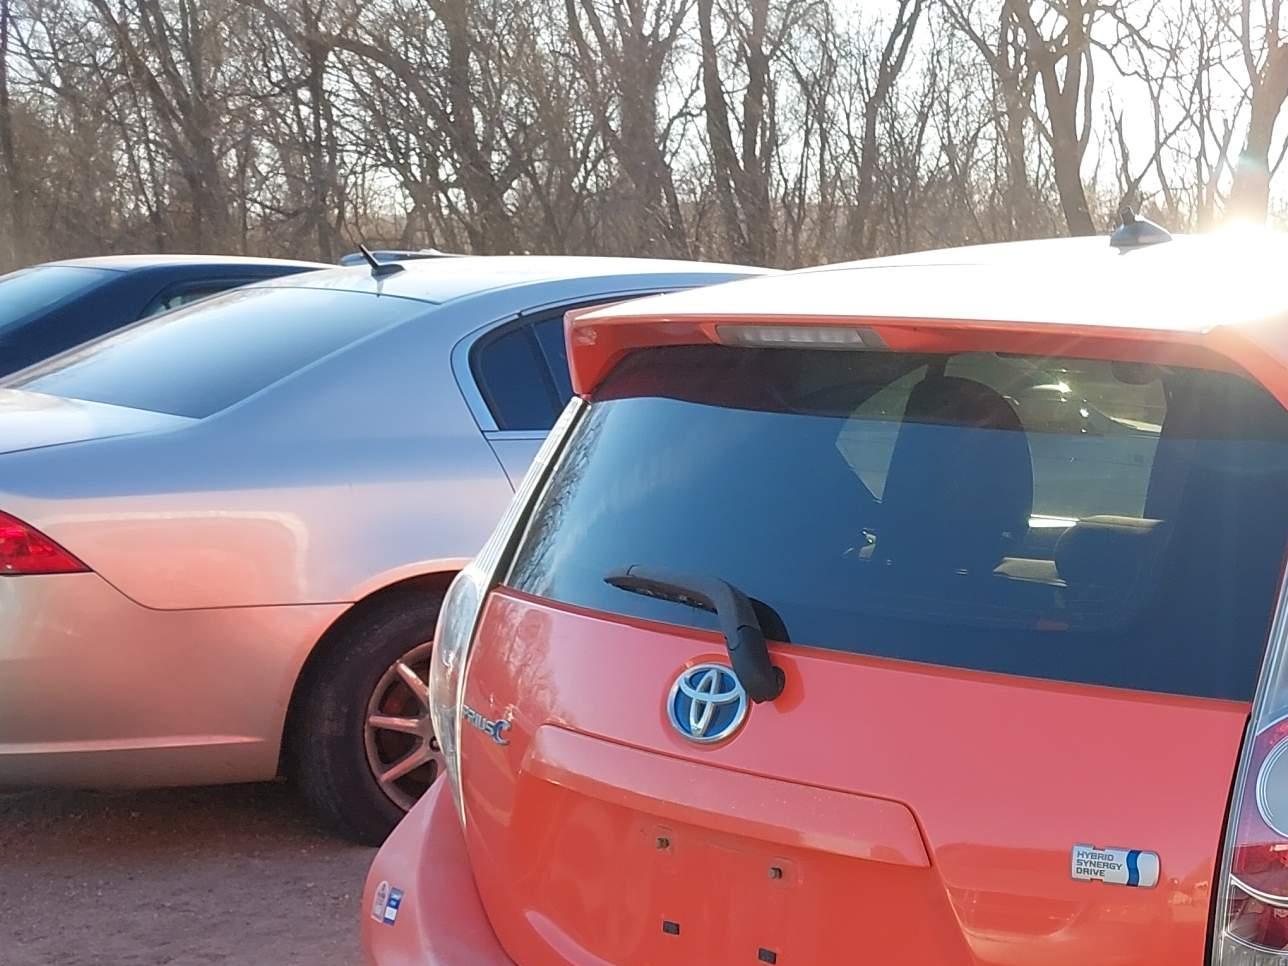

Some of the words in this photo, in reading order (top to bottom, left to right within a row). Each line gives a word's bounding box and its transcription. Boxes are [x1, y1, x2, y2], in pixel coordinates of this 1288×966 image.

[1076, 850, 1114, 861] HYBRID
[1076, 859, 1123, 871] SYNERGY
[1076, 867, 1105, 877] DRIVE
